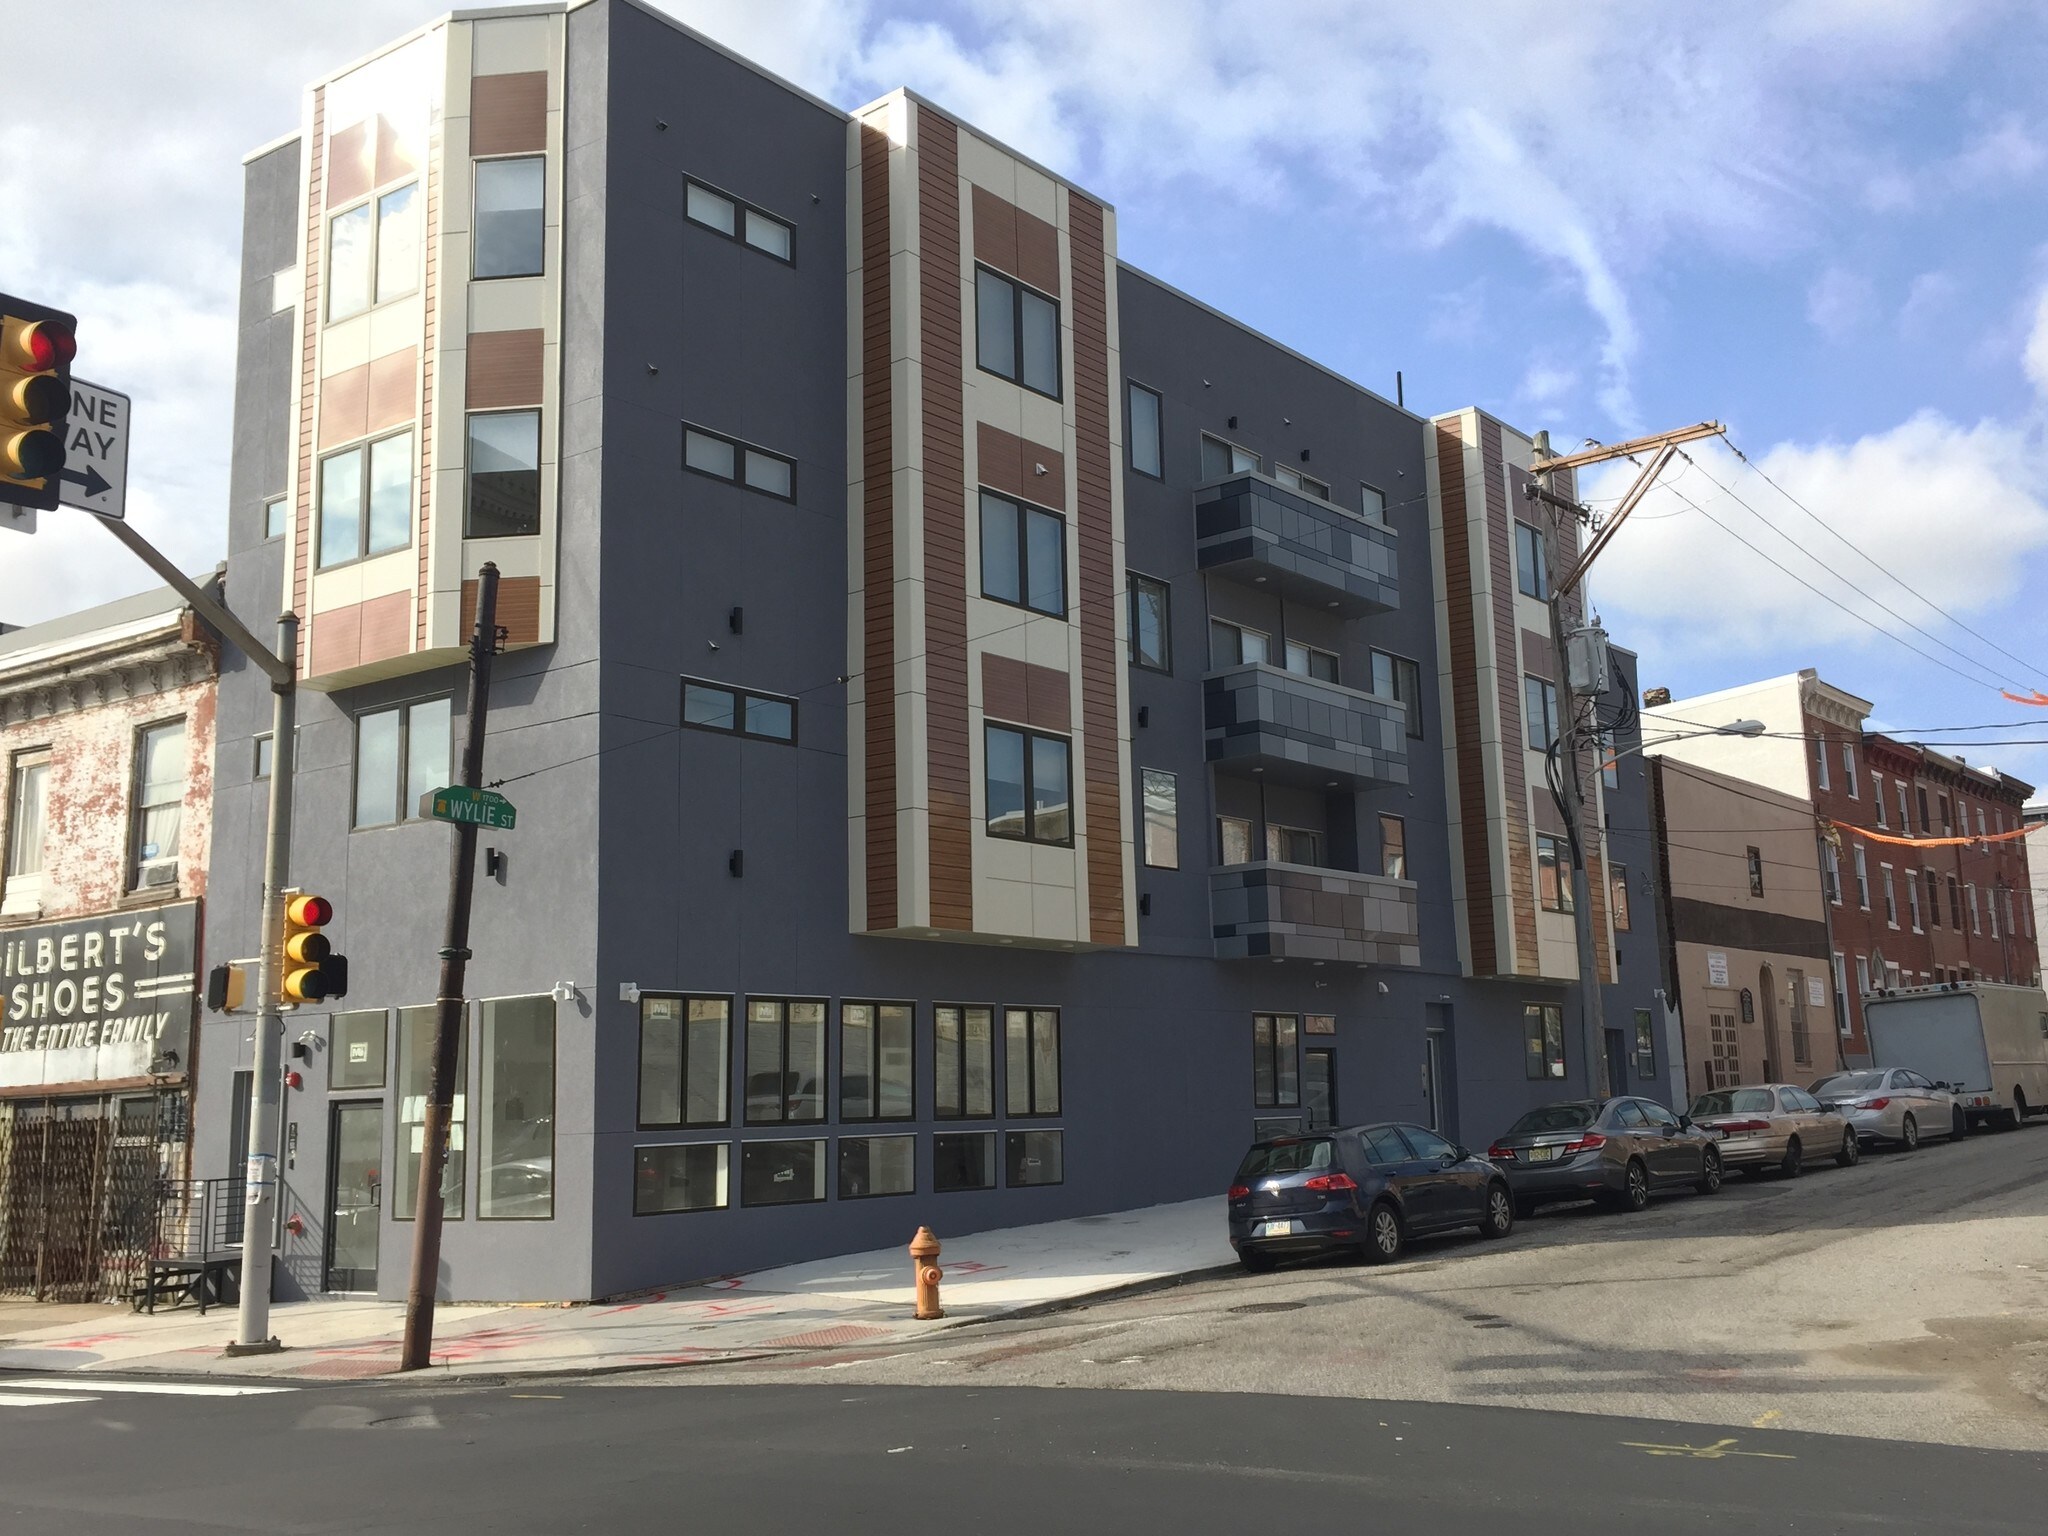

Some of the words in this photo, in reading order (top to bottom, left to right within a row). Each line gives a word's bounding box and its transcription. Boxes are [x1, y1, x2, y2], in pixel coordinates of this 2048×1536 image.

[72, 390, 118, 429] NE
[70, 428, 116, 461] AY
[450, 799, 496, 825] WYLIE
[501, 814, 514, 828] ST
[482, 794, 499, 804] 1700
[0, 921, 167, 977] ILBERT'S
[8, 972, 125, 1020] SHOES
[2, 1025, 34, 1053] THE
[35, 1020, 99, 1050] ENTIRE
[100, 1011, 171, 1046] FAMILY
